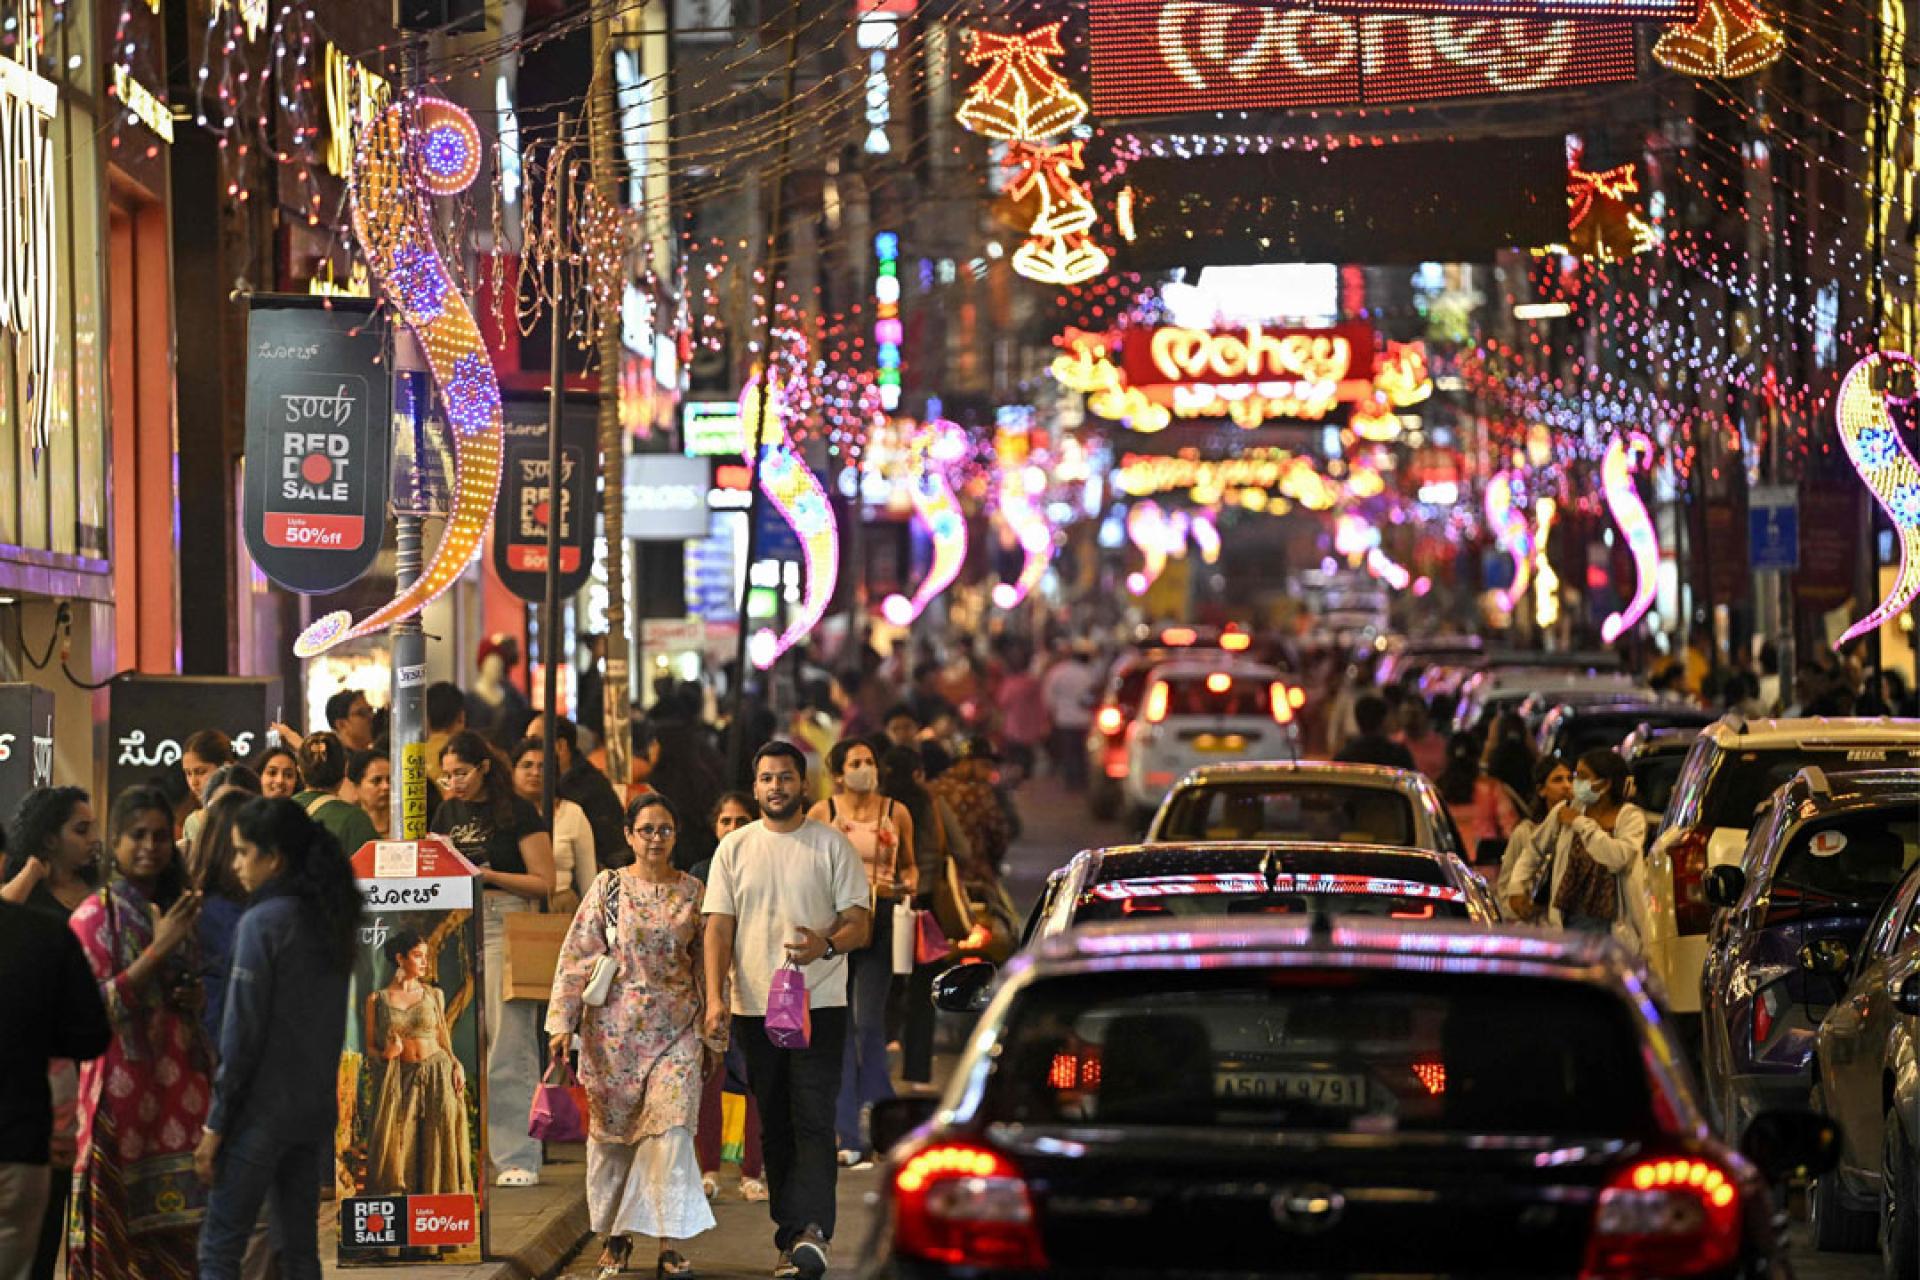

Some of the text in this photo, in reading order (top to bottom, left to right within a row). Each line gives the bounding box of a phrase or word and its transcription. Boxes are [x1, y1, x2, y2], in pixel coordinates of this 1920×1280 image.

[1152, 324, 1350, 382] Mohey
[280, 384, 356, 427] soch
[283, 432, 350, 457] RED
[281, 480, 349, 501] SALE
[354, 1201, 395, 1216] RED
[354, 1230, 396, 1244] SALE
